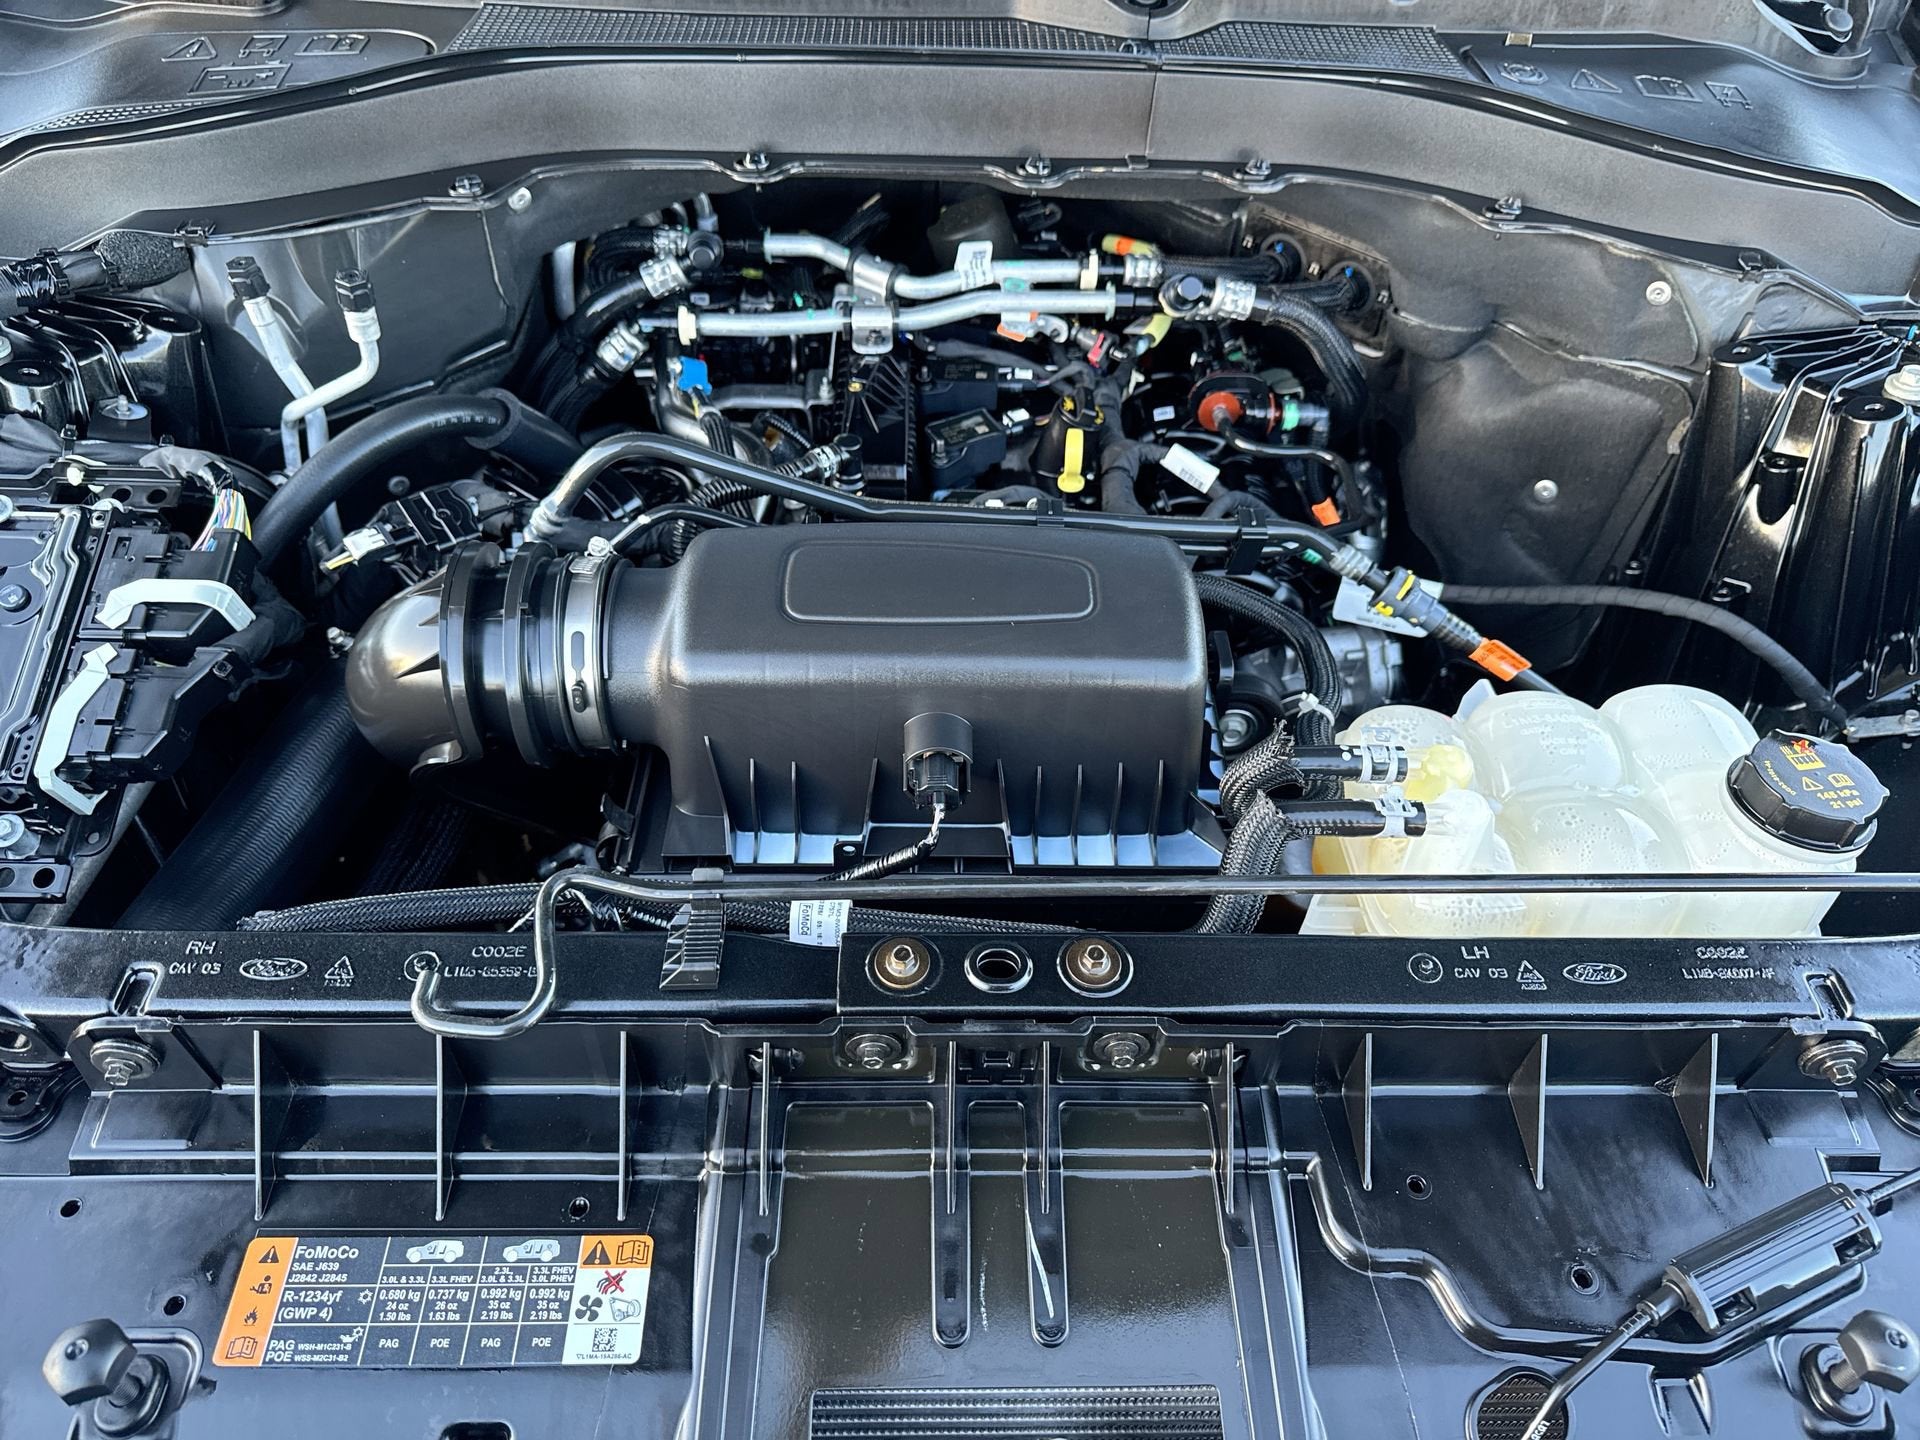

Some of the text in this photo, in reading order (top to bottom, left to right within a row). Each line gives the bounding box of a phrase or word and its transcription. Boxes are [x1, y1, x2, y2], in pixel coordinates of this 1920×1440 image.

[1816, 788, 1860, 801] 145 kPa
[1830, 797, 1864, 809] 21 psi
[802, 904, 810, 936] FoMoCo
[185, 940, 216, 954] RH
[1460, 946, 1490, 960] LH
[1454, 967, 1480, 978] CAV
[1569, 963, 1621, 983] Ford
[295, 1246, 359, 1260] FoMoCo
[292, 1262, 340, 1272] SAE J639
[494, 1267, 514, 1276] 2.3L,
[533, 1266, 575, 1274] 3.3L FHEV
[288, 1274, 348, 1283] J2842 J2845
[382, 1276, 426, 1284] 3.0L & 3.3L
[432, 1276, 473, 1284] 3.3L FHEV
[480, 1276, 524, 1284] 3.0L & 3.3L
[532, 1274, 574, 1282] 3.0L PHEV
[283, 1290, 343, 1303] R-1234yf
[379, 1290, 420, 1302] 0.680 kg
[428, 1289, 470, 1302] 0.737 kg
[480, 1288, 522, 1302] 0.992 kg
[530, 1288, 570, 1302] 0.992 kg
[385, 1302, 397, 1310] 24
[434, 1301, 458, 1310] 26 oz
[488, 1300, 510, 1310] 35 oz
[536, 1300, 559, 1310] 35 oz
[278, 1307, 333, 1322] (GWP 4)
[379, 1312, 412, 1321] 1.50 lbs
[428, 1312, 460, 1320] 1.63 lbs
[480, 1311, 514, 1320] 2.19 lbs
[530, 1311, 562, 1320] 2.19 lbs
[269, 1340, 295, 1351] PAG
[378, 1339, 399, 1348] PAG
[430, 1338, 450, 1348] POE
[480, 1338, 501, 1348] PAG
[532, 1338, 552, 1347] POE
[266, 1351, 294, 1362] POE
